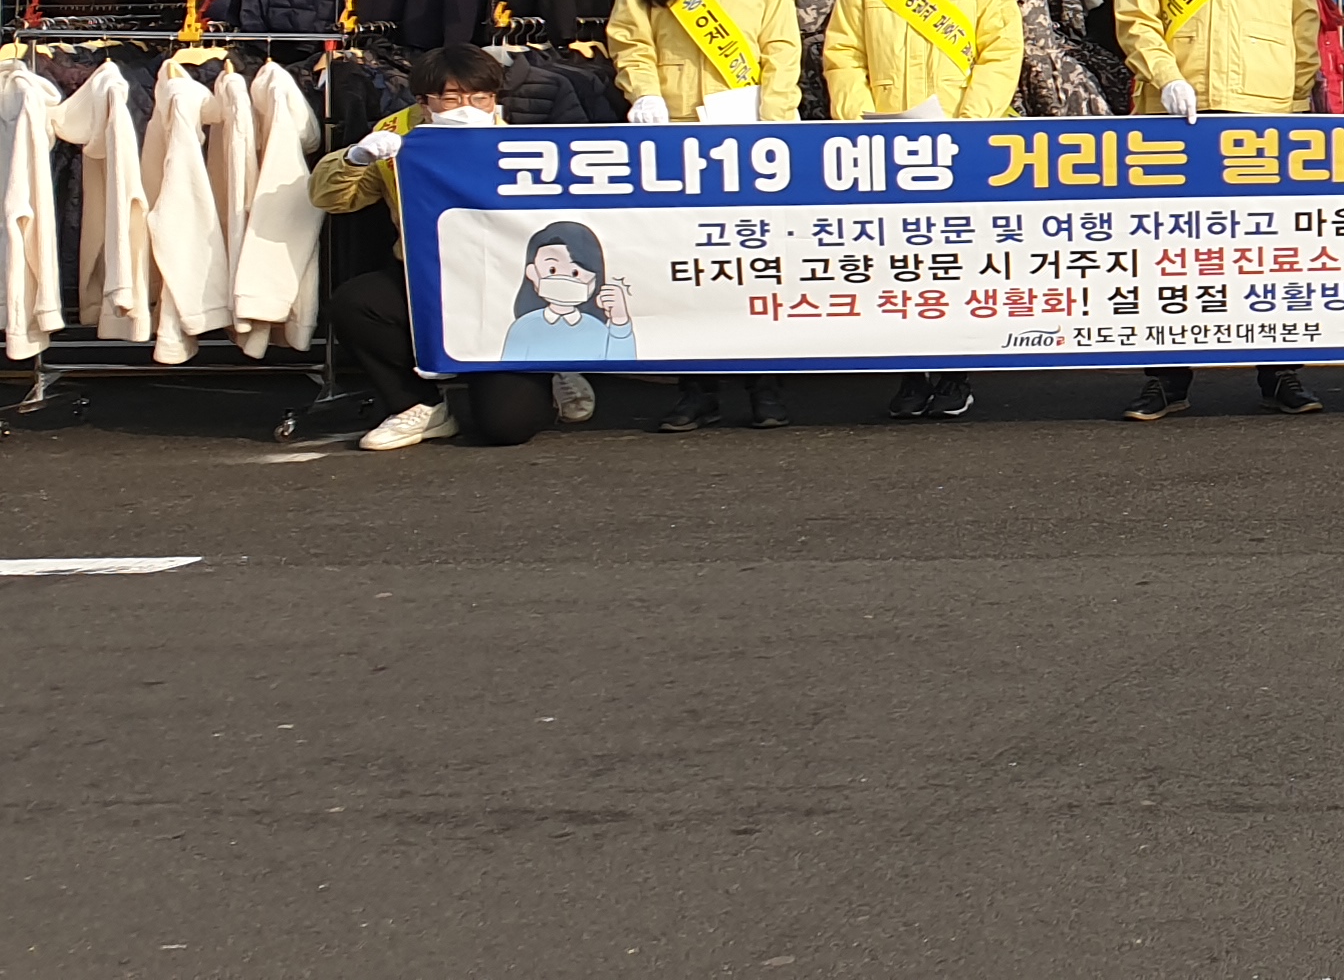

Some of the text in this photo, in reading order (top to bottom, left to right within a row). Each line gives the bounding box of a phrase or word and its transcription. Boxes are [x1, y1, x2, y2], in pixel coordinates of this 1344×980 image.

[695, 10, 739, 58] 이제는
[498, 138, 790, 195] 코로나19
[824, 134, 959, 191] 예방
[988, 131, 1187, 188] 거리는
[696, 220, 770, 249] 고향
[813, 218, 884, 246] 친지
[903, 217, 975, 245] 방문
[993, 215, 1022, 243] 및
[1043, 213, 1112, 241] 여행
[1130, 210, 1278, 240] 자제하고
[671, 257, 781, 286] 타지역
[800, 255, 873, 283] 고향
[890, 254, 962, 282] 방문
[980, 252, 1010, 280] 시
[1031, 249, 1137, 279] 거주지
[1155, 239, 1341, 276] 선별진료소
[749, 293, 860, 321] 마스크
[878, 290, 949, 319] 착용
[965, 287, 1089, 318] 생활화!
[1108, 286, 1139, 314] 설
[1159, 284, 1227, 314] 명절
[1001, 328, 1057, 350] Jindo
[1074, 323, 1325, 349] 진도군 재난안전대책본부
